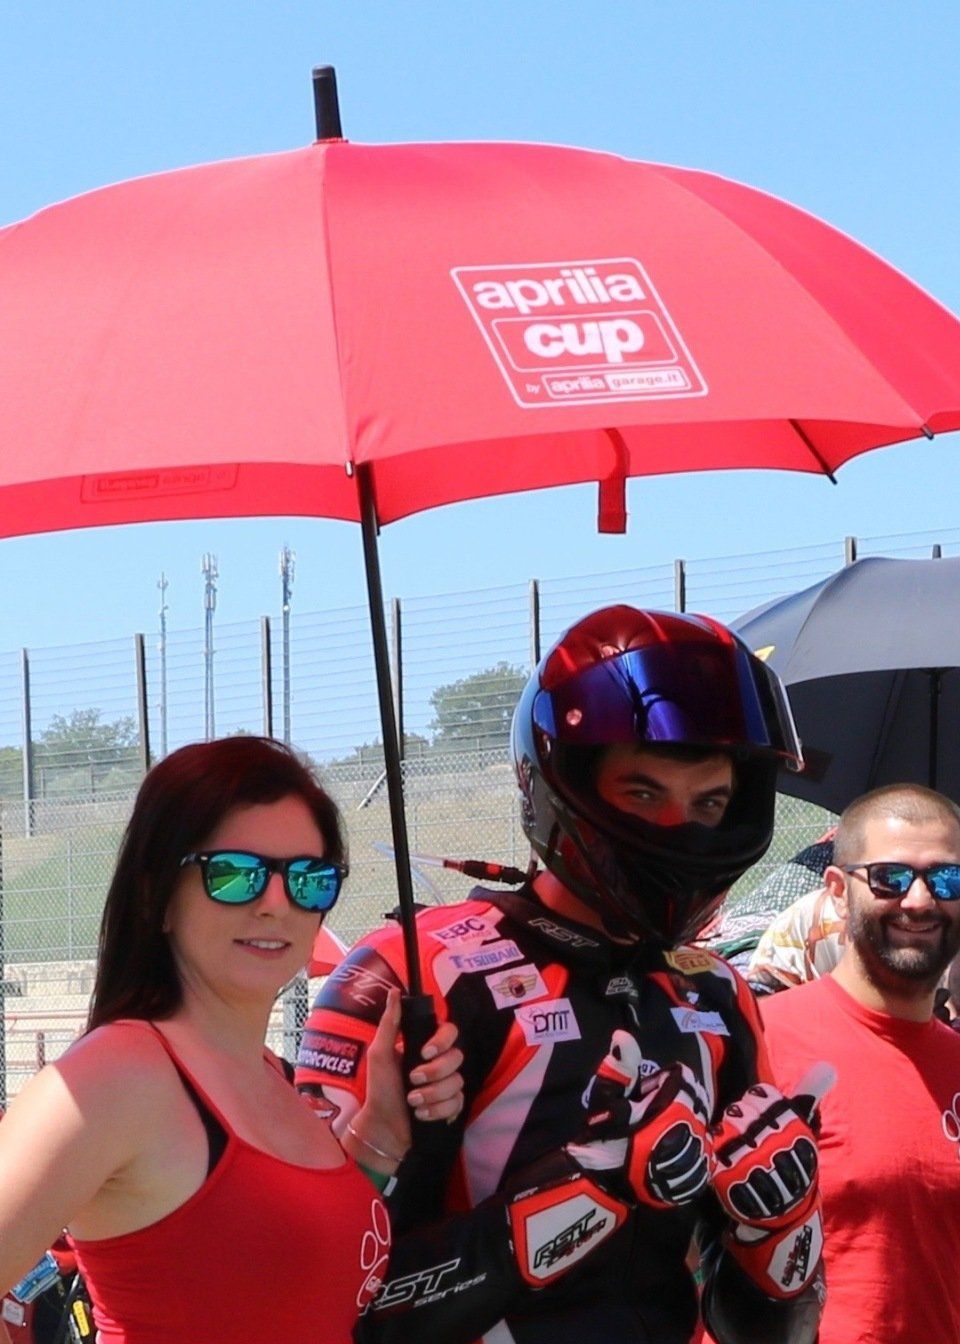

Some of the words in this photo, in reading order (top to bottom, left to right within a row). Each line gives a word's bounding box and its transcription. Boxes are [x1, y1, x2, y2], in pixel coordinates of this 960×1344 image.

[473, 267, 647, 314] aprilia
[523, 318, 645, 364] cup
[526, 382, 541, 394] by
[551, 374, 606, 393] aprilia
[611, 370, 679, 387] garage.it
[437, 918, 486, 941] EBC
[528, 917, 600, 948] RST
[532, 1009, 570, 1034] DMT
